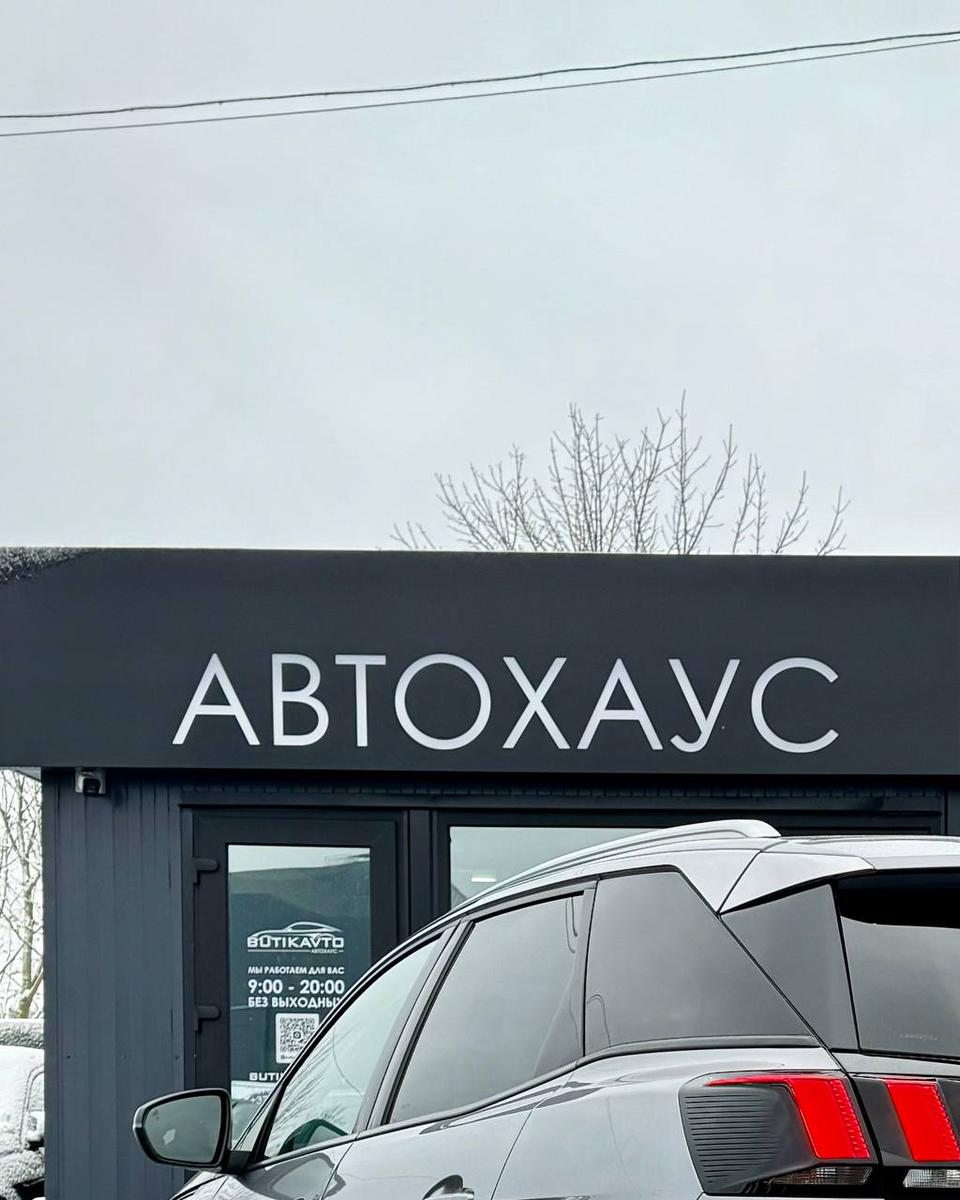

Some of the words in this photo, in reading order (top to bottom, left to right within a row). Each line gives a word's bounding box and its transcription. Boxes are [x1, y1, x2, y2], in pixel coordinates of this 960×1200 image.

[171, 652, 840, 754] АВТОХАУС
[247, 936, 344, 948] BUTIKAVTO
[248, 967, 263, 975] МЫ
[264, 967, 307, 975] РАБОТАЕМ
[308, 967, 326, 975] ДЛЯ
[327, 967, 345, 975] ВАС
[248, 979, 283, 994] 9:00
[300, 979, 345, 994] 20:00
[248, 997, 268, 1008] БЕЗ
